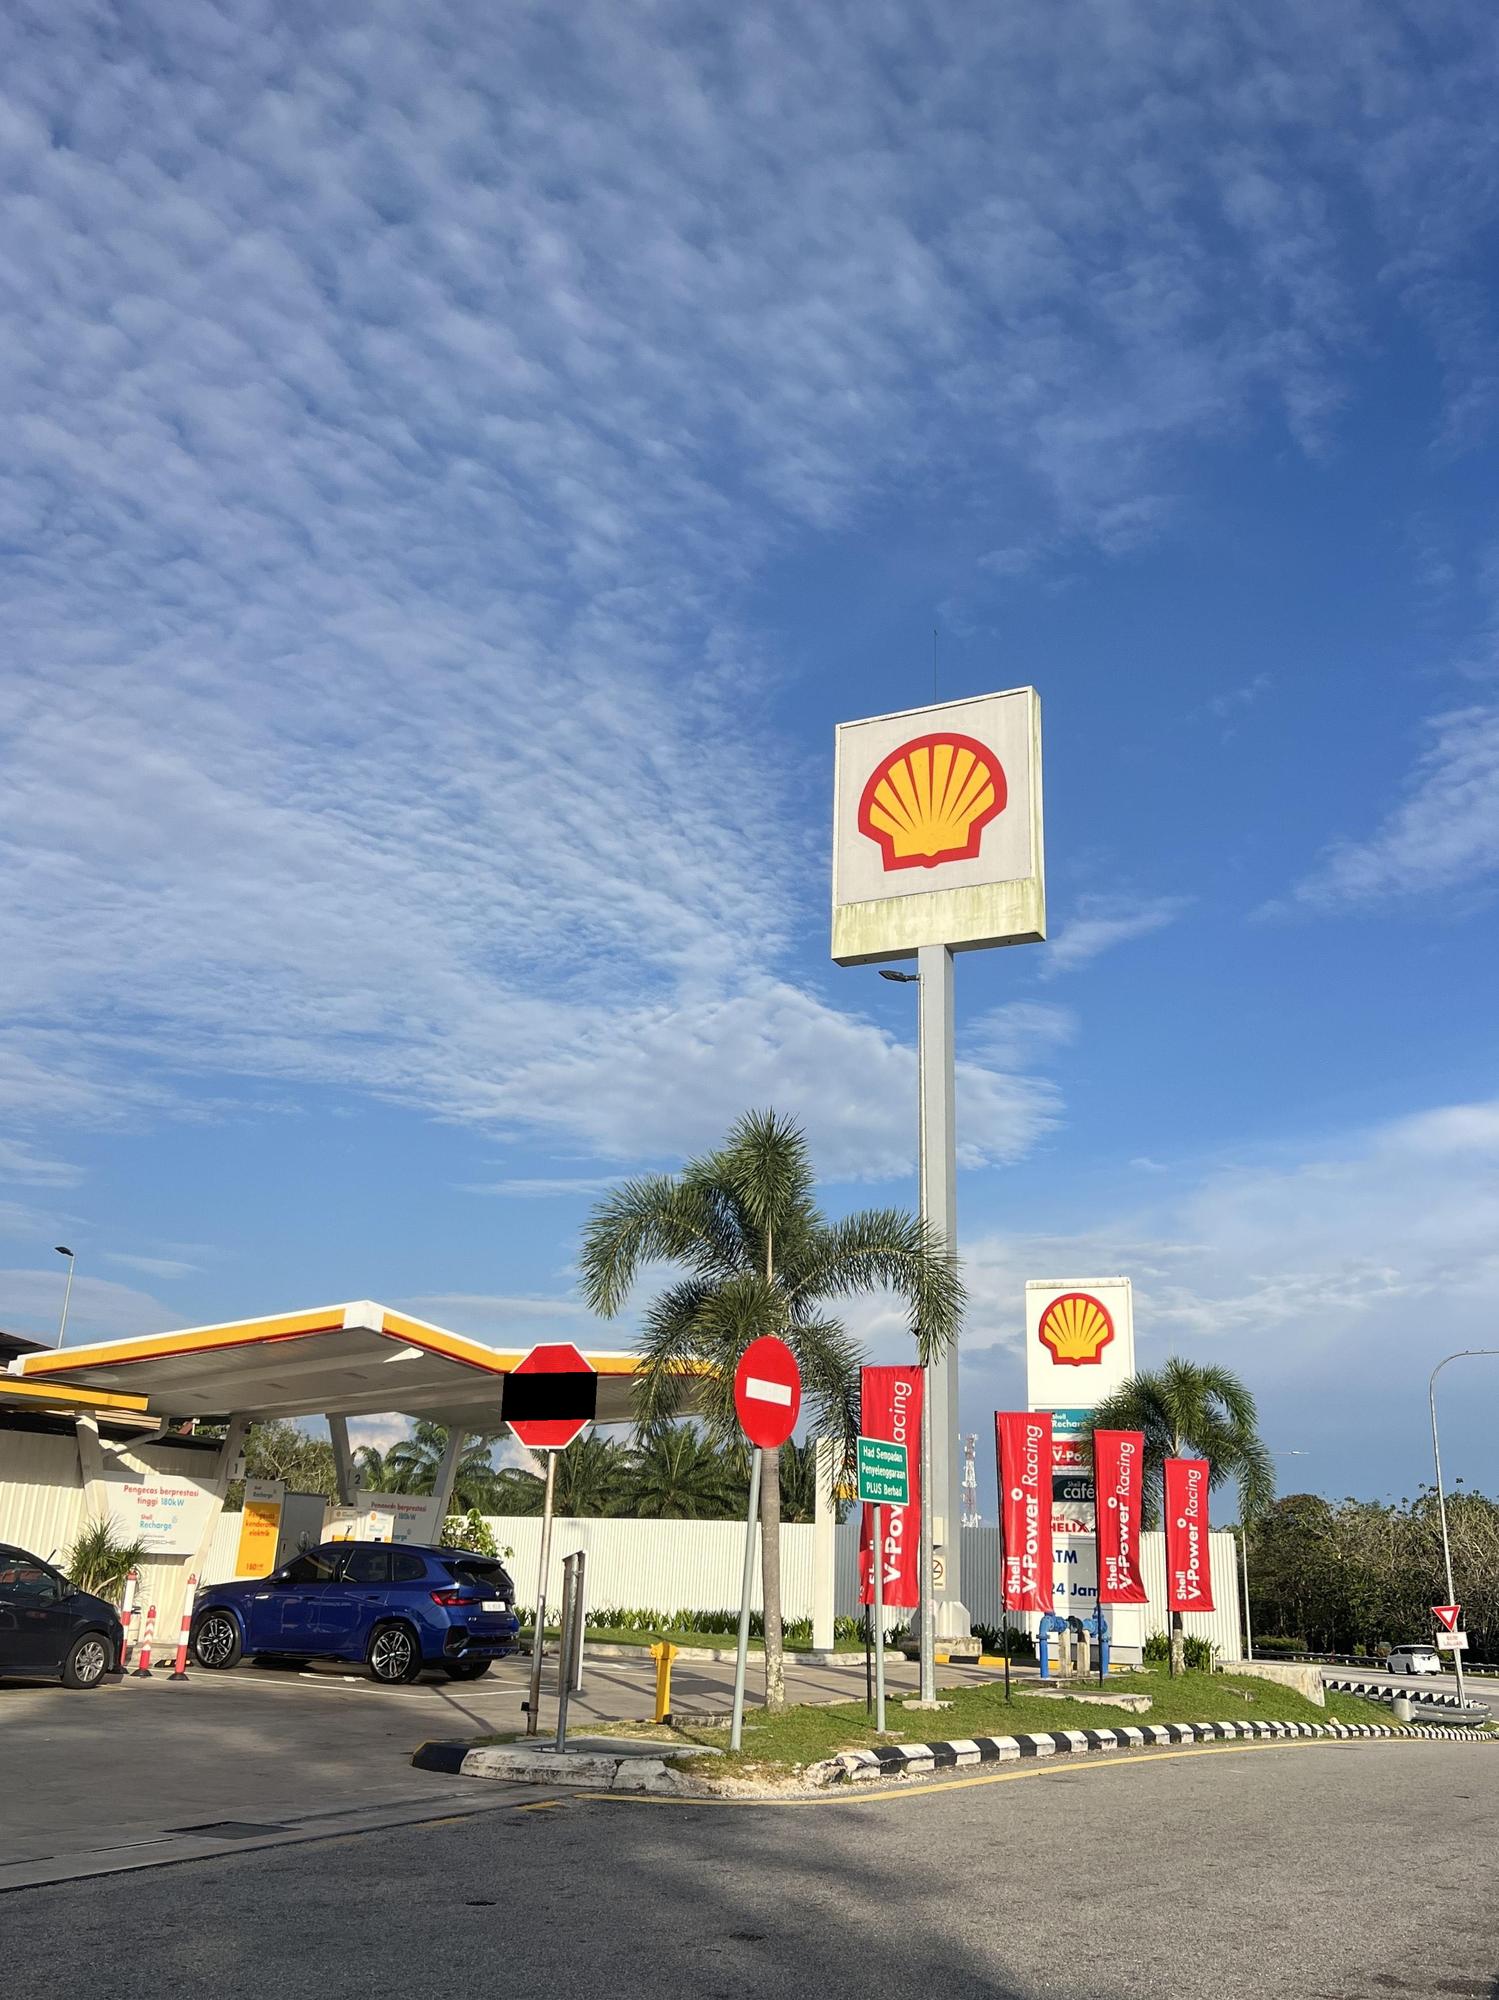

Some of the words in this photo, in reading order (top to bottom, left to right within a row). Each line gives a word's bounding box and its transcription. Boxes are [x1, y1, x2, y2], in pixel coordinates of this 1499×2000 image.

[889, 1381, 912, 1444] acing
[1051, 1419, 1084, 1429] Rechar
[863, 1445, 875, 1458] Had
[876, 1448, 903, 1463] Sempadan
[1021, 1425, 1043, 1487] Racing
[1052, 1450, 1083, 1462] V-Po
[354, 1474, 361, 1485] 2
[861, 1462, 906, 1479] Penyelenggaraan
[1116, 1441, 1135, 1496] Racing
[123, 1484, 158, 1496] Pengecas
[160, 1487, 200, 1497] berprestasi
[866, 1481, 882, 1495] PLUS
[883, 1484, 903, 1497] Berhad
[1063, 1483, 1095, 1499] café
[1185, 1469, 1201, 1517] Racing
[137, 1497, 159, 1507] tinggi
[139, 1520, 172, 1531] Recharge
[1022, 1493, 1038, 1593] V-Power
[1118, 1502, 1133, 1590] V-Power
[1106, 1556, 1117, 1590] Shell
[1187, 1523, 1201, 1600] V-Power
[1007, 1556, 1021, 1594] Shell
[1175, 1570, 1187, 1600] Shell
